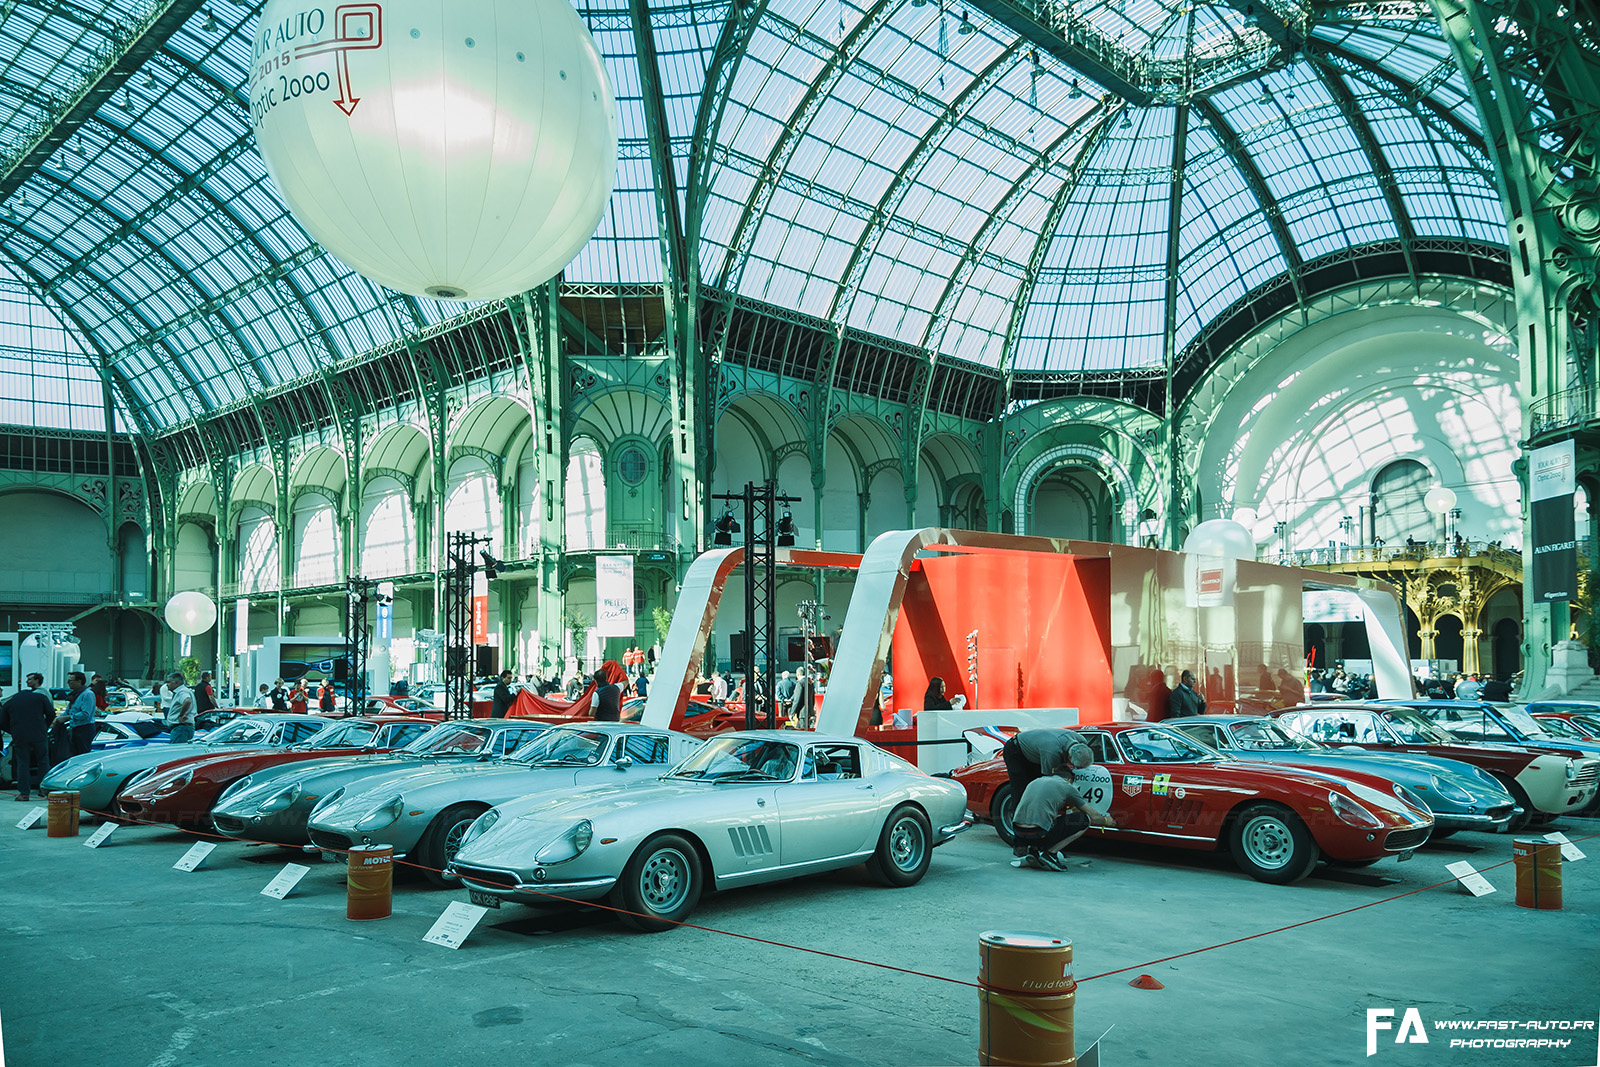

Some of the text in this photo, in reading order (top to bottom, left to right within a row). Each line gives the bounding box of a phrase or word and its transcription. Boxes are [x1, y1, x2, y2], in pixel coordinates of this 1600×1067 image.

[251, 8, 325, 67] OUR AUTO
[258, 50, 291, 81] 2015
[251, 71, 330, 129] Optic 2000
[1075, 773, 1111, 783] ptic 2000
